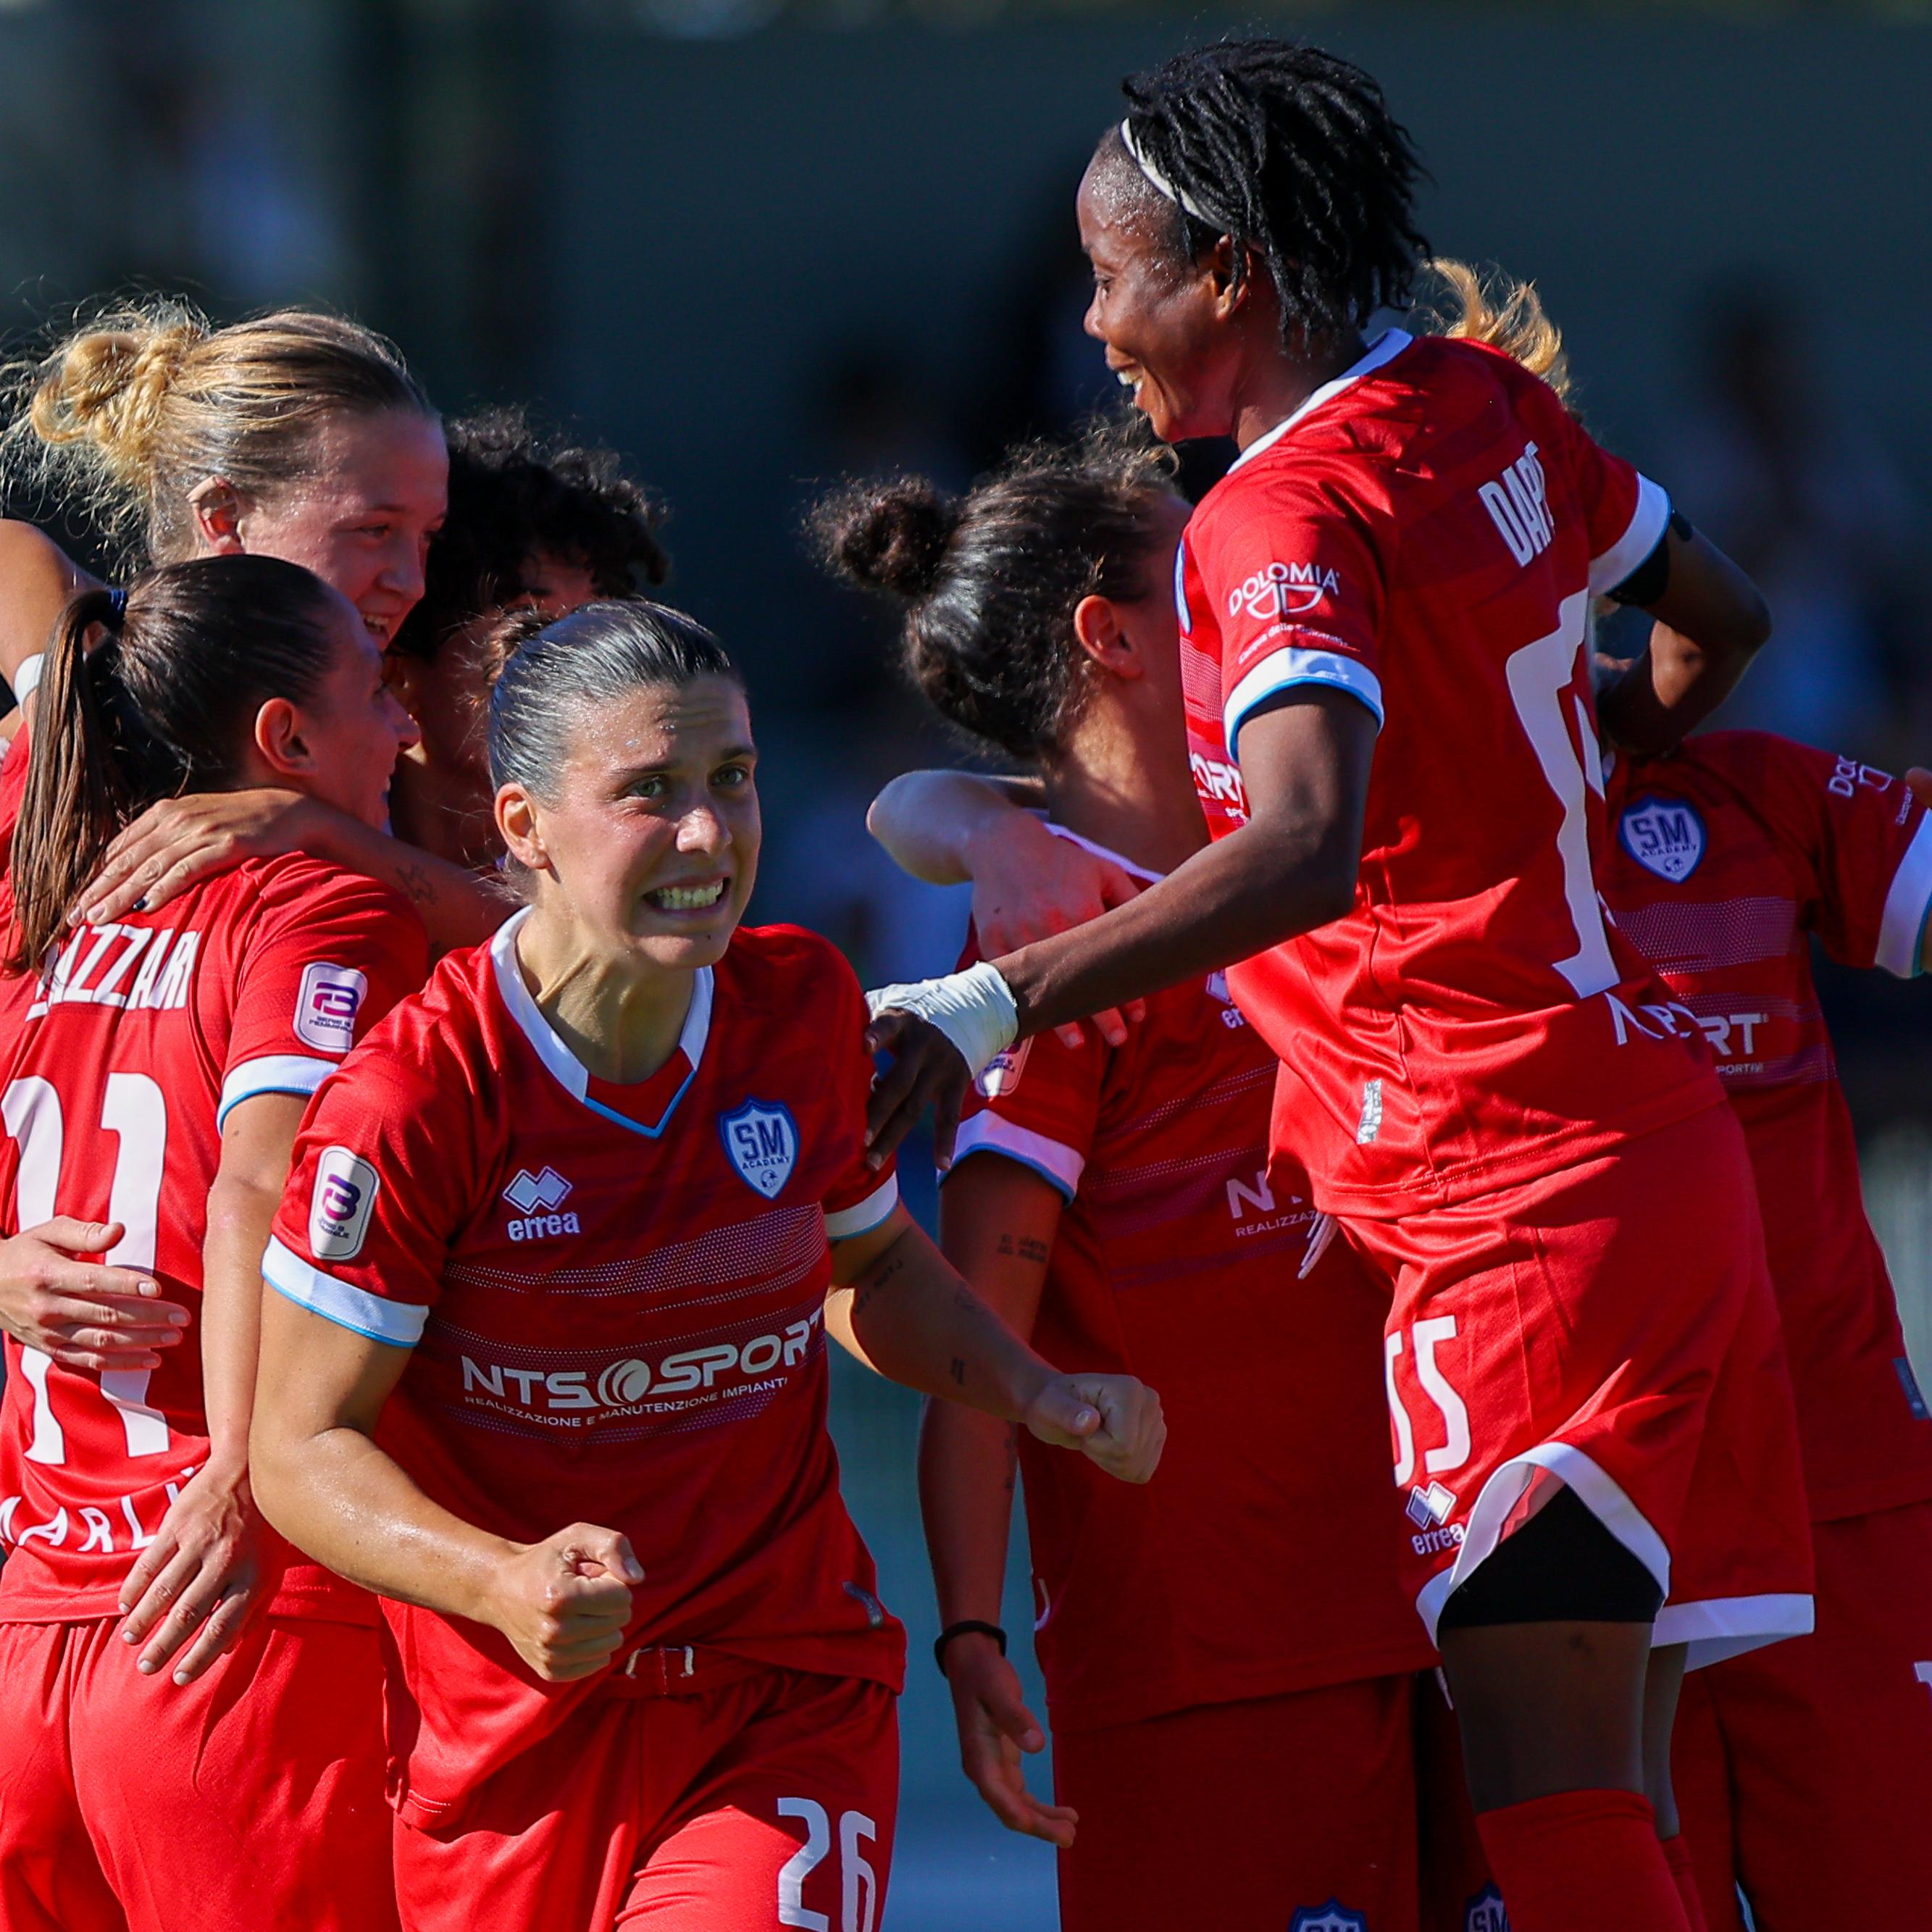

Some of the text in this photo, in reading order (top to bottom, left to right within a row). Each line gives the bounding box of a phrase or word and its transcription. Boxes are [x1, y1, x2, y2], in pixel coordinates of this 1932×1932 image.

[1229, 562, 1339, 617] DOLOMIA
[1189, 753, 1244, 809] ORT
[1631, 814, 1691, 849] SM
[734, 1116, 785, 1161] SM
[742, 1156, 790, 1170] ACADEMY
[507, 1211, 580, 1242] errea
[1236, 1209, 1317, 1237] REALIZZAZ
[461, 1355, 601, 1408] NTS
[1385, 1315, 1471, 1487] 55
[464, 1395, 582, 1427] REALIZZAZIONE
[586, 1415, 595, 1425] E
[598, 1392, 719, 1421] MANUTENZIONE
[1412, 1523, 1464, 1556] errea
[777, 1797, 876, 1932] 26
